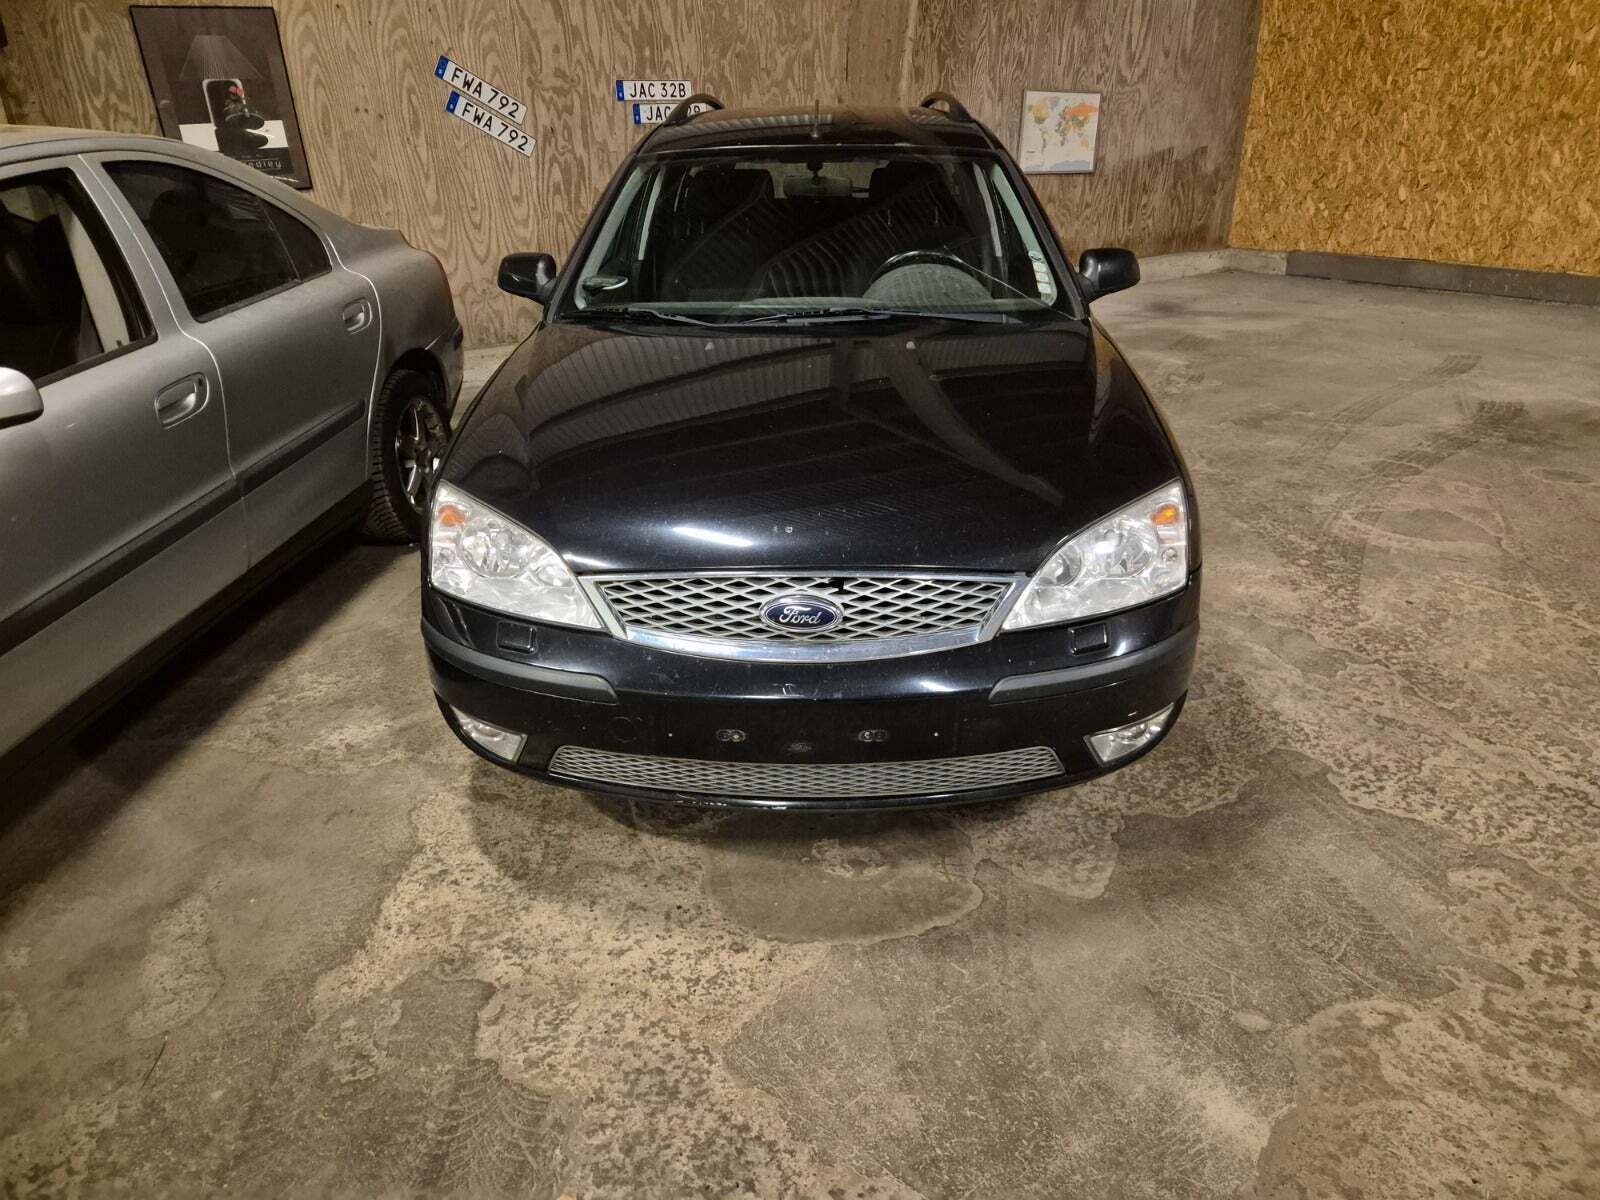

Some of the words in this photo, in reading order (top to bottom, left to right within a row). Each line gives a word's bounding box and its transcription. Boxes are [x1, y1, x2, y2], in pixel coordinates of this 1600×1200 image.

[451, 67, 482, 98] FWA
[488, 88, 519, 118] 792
[630, 83, 656, 98] JAC
[661, 83, 686, 98] 32B
[462, 102, 493, 131] FWA
[498, 122, 528, 151] 792
[779, 605, 822, 624] Ford
